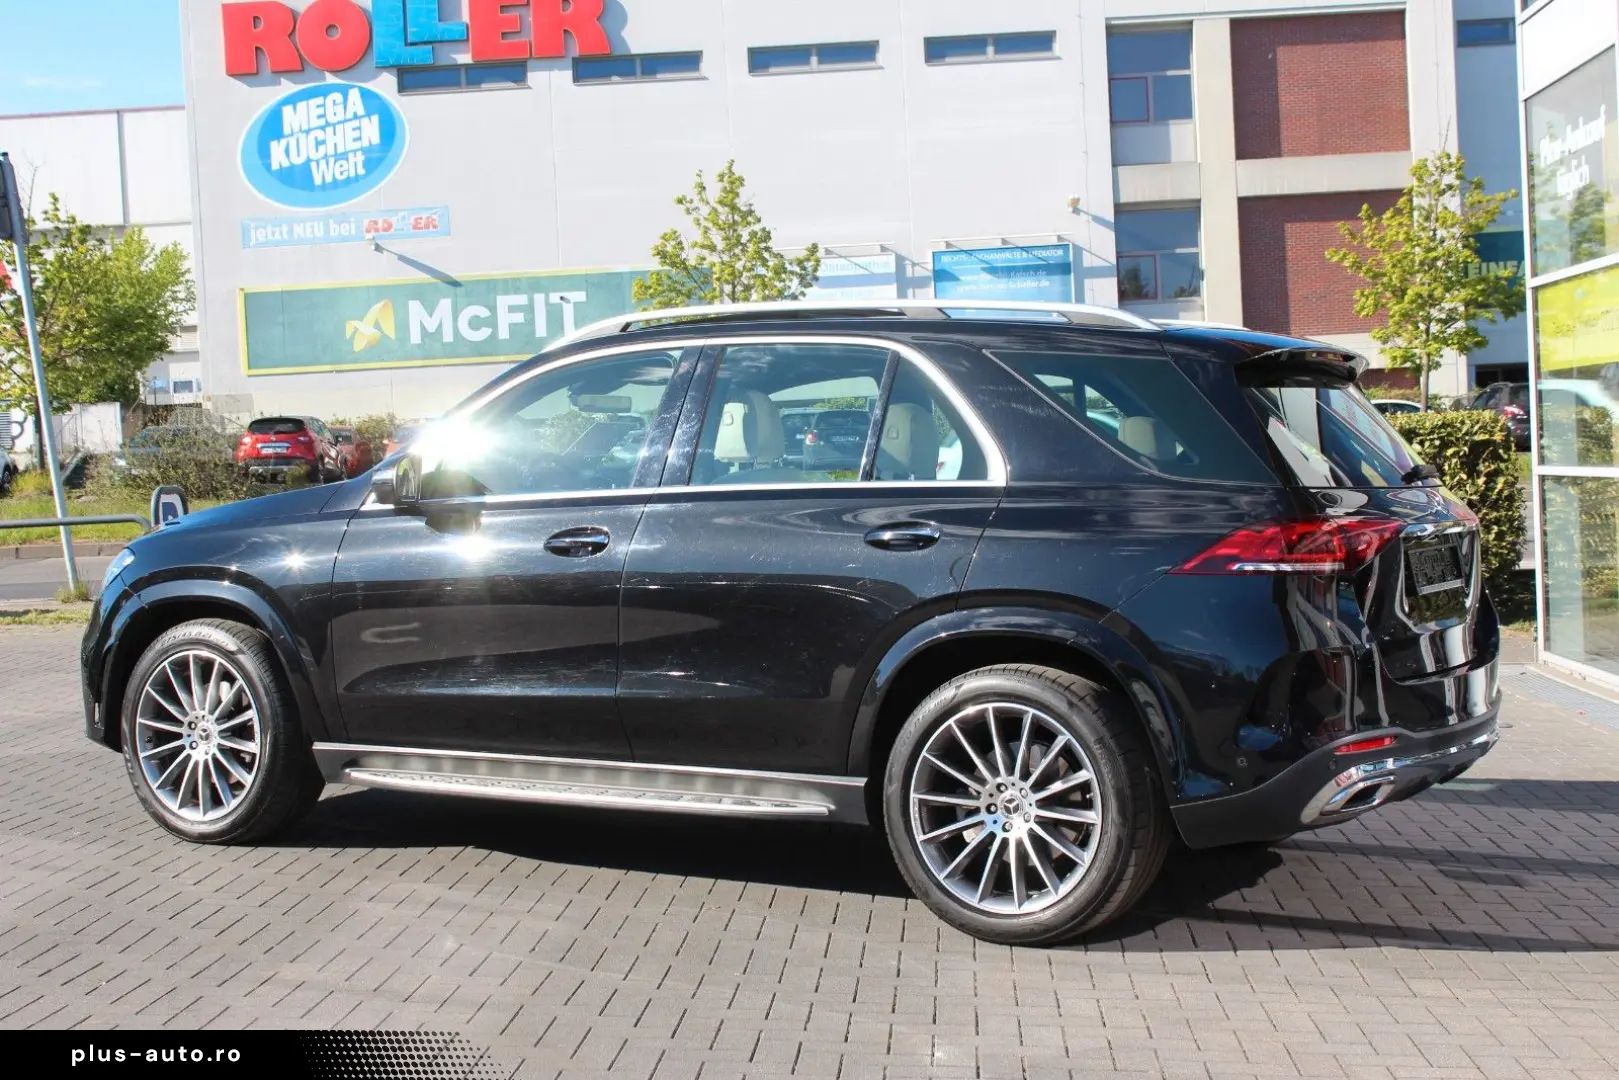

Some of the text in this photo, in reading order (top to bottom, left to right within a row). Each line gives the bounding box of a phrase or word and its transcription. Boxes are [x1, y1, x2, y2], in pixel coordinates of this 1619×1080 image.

[221, 0, 612, 76] ROLLER
[282, 87, 366, 136] MEGA
[310, 150, 366, 187] Welt
[249, 220, 288, 246] jetzt
[293, 219, 325, 238] NEU
[329, 218, 356, 236] bei
[408, 291, 587, 345] McFIT
